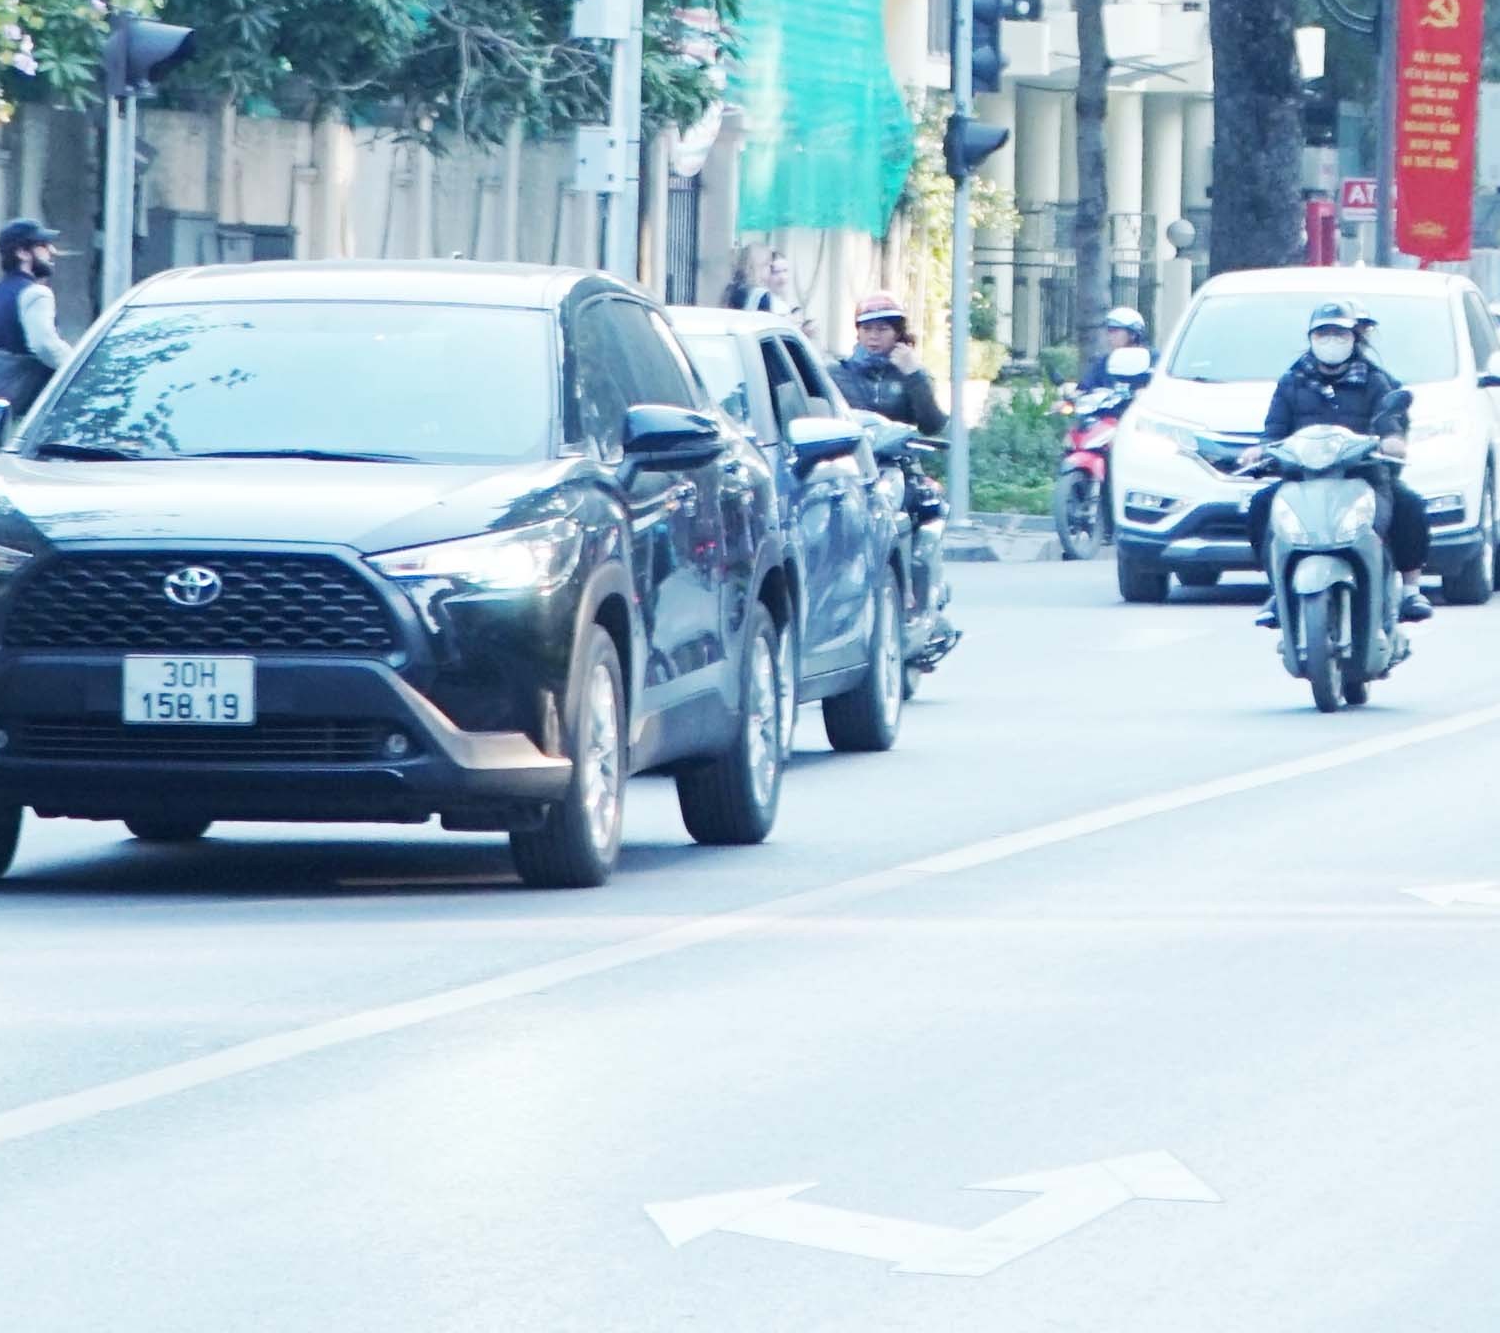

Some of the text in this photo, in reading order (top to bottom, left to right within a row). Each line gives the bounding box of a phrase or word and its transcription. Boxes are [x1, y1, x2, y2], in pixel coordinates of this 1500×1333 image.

[1350, 184, 1395, 205] AT
[162, 661, 217, 688] 30H
[142, 692, 240, 720] 158.19
